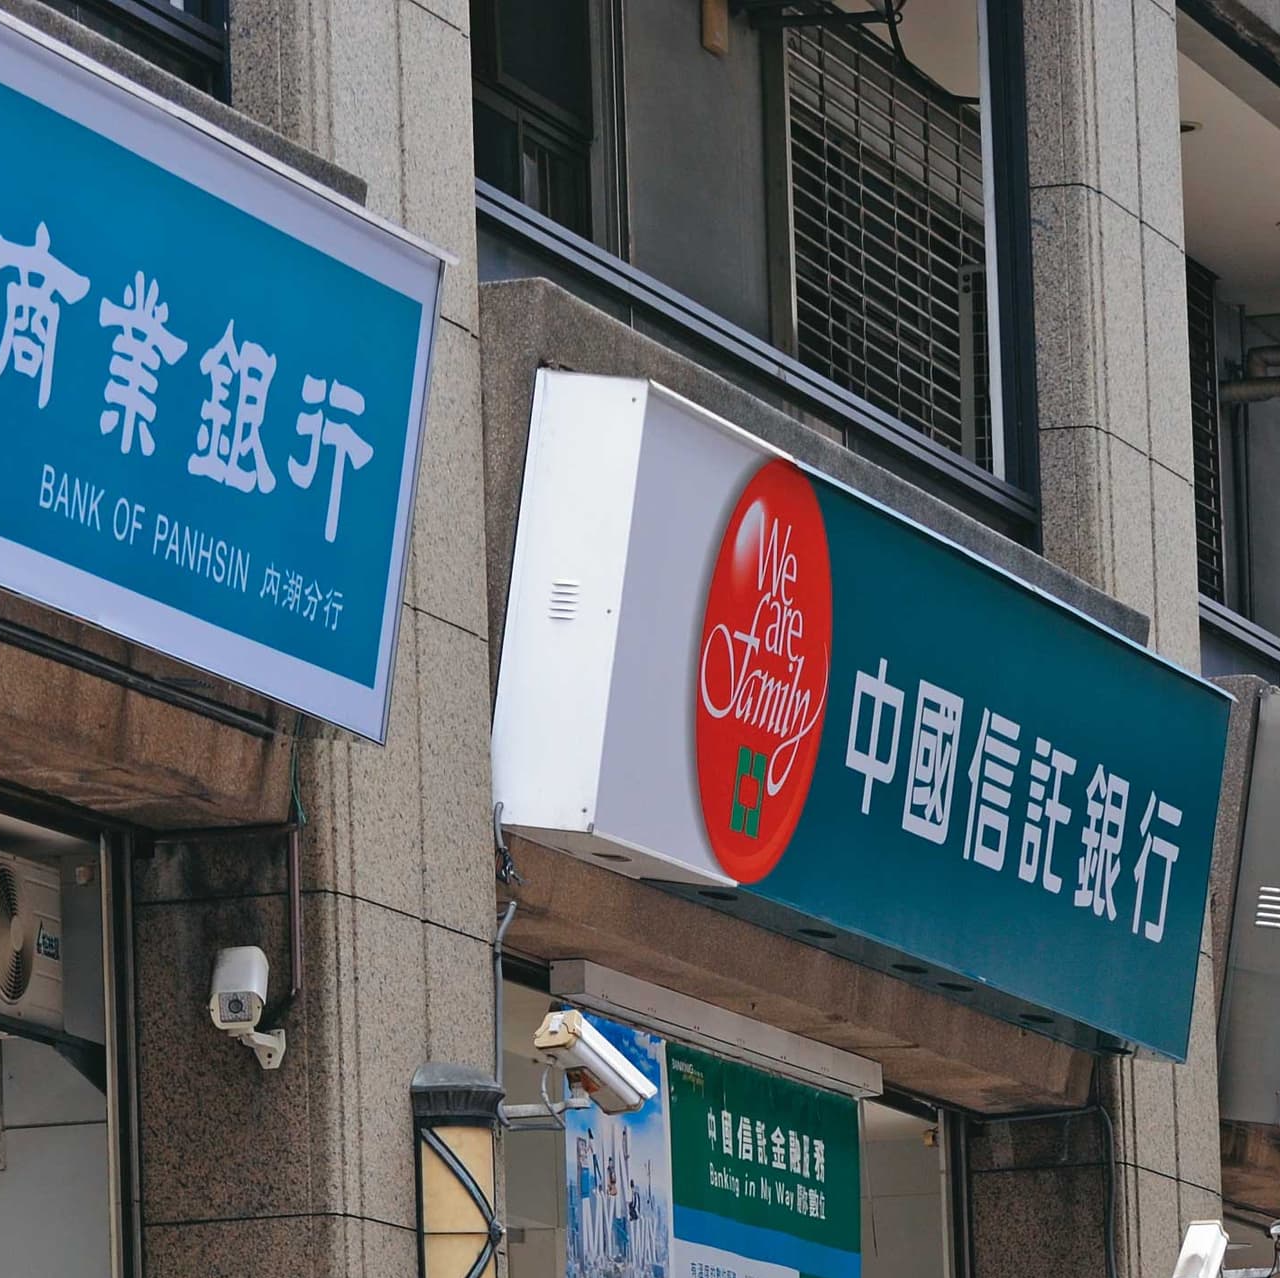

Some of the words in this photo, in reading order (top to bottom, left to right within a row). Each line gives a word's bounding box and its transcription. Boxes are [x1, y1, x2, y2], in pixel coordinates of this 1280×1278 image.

[37, 463, 102, 535] BANK
[112, 496, 145, 547] OF
[152, 513, 251, 594] PANHSIN
[756, 516, 798, 606] We
[259, 561, 344, 633] 內湖分行
[750, 593, 803, 664] Care
[700, 622, 830, 797] Family
[845, 657, 1183, 944] 中國信託銀行
[709, 1162, 740, 1197] Banking
[745, 1173, 756, 1198] in
[760, 1176, 773, 1206] My
[775, 1180, 795, 1211] Way
